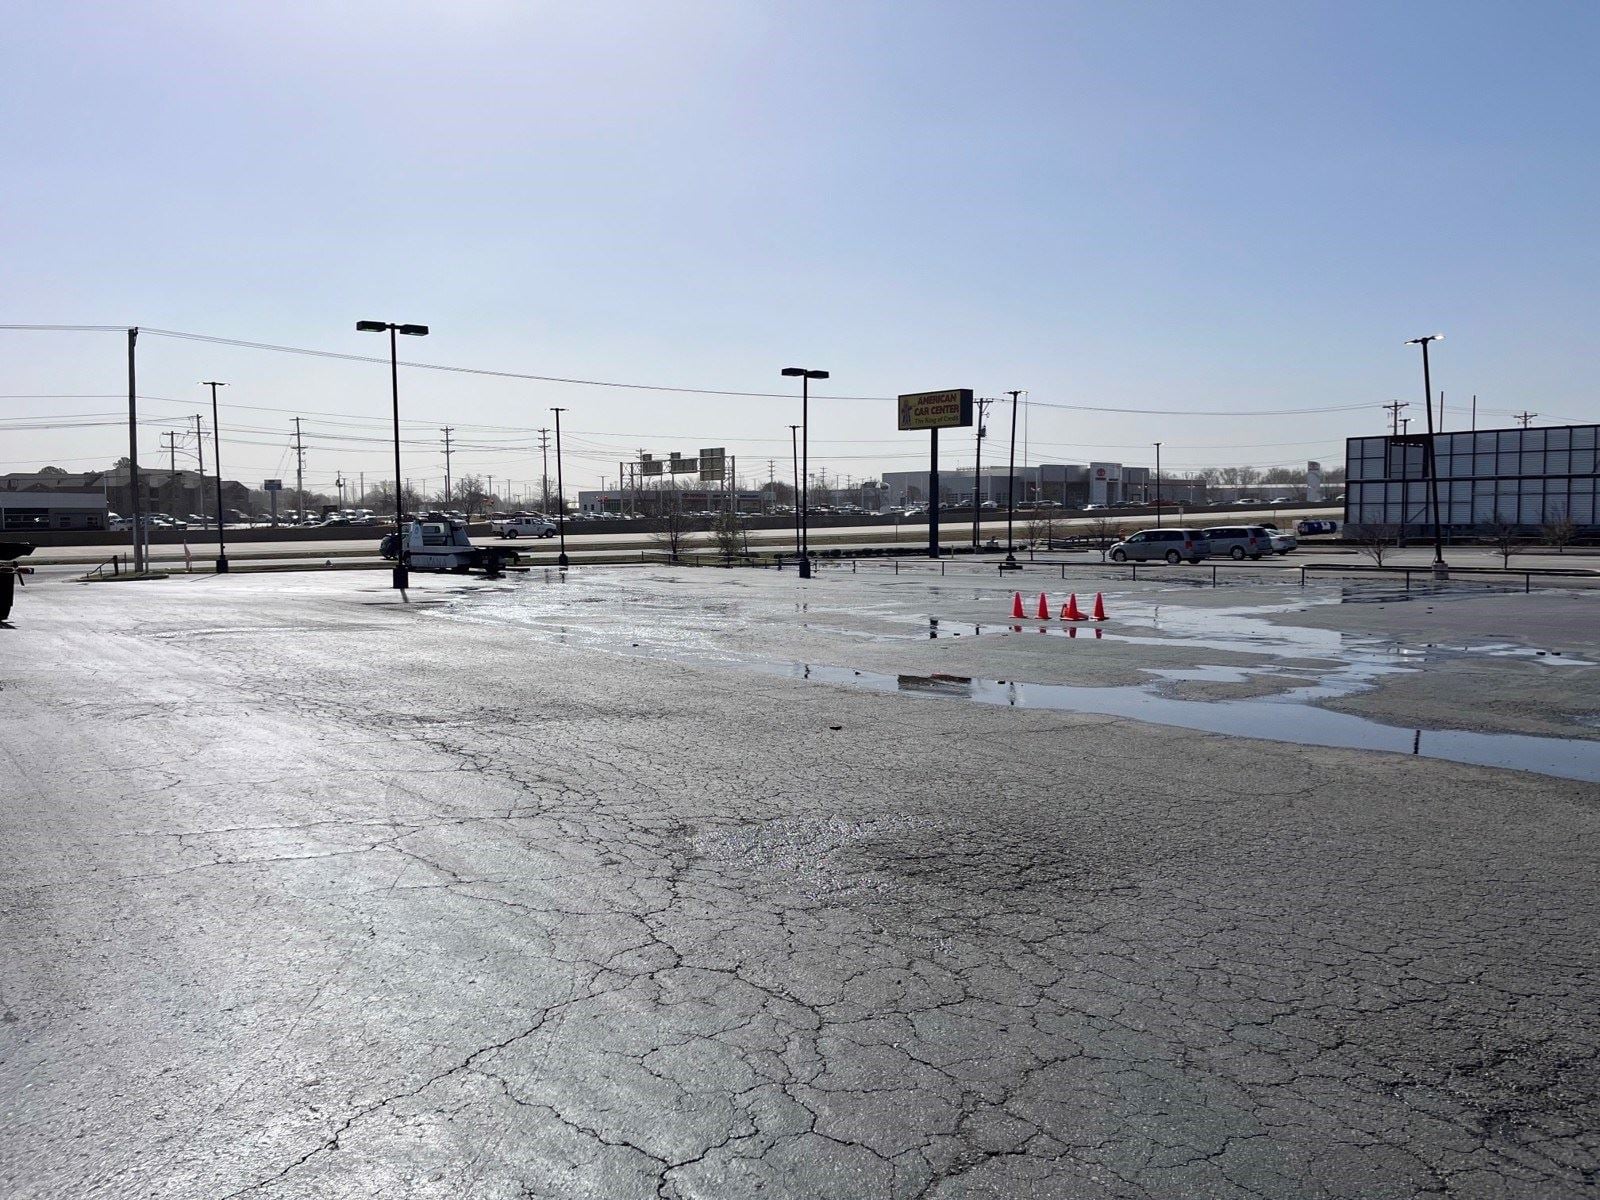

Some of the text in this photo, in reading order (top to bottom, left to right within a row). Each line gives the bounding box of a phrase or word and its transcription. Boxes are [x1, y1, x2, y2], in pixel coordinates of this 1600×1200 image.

[917, 393, 957, 405] AMERICAN
[914, 404, 960, 416] CAR CENTER
